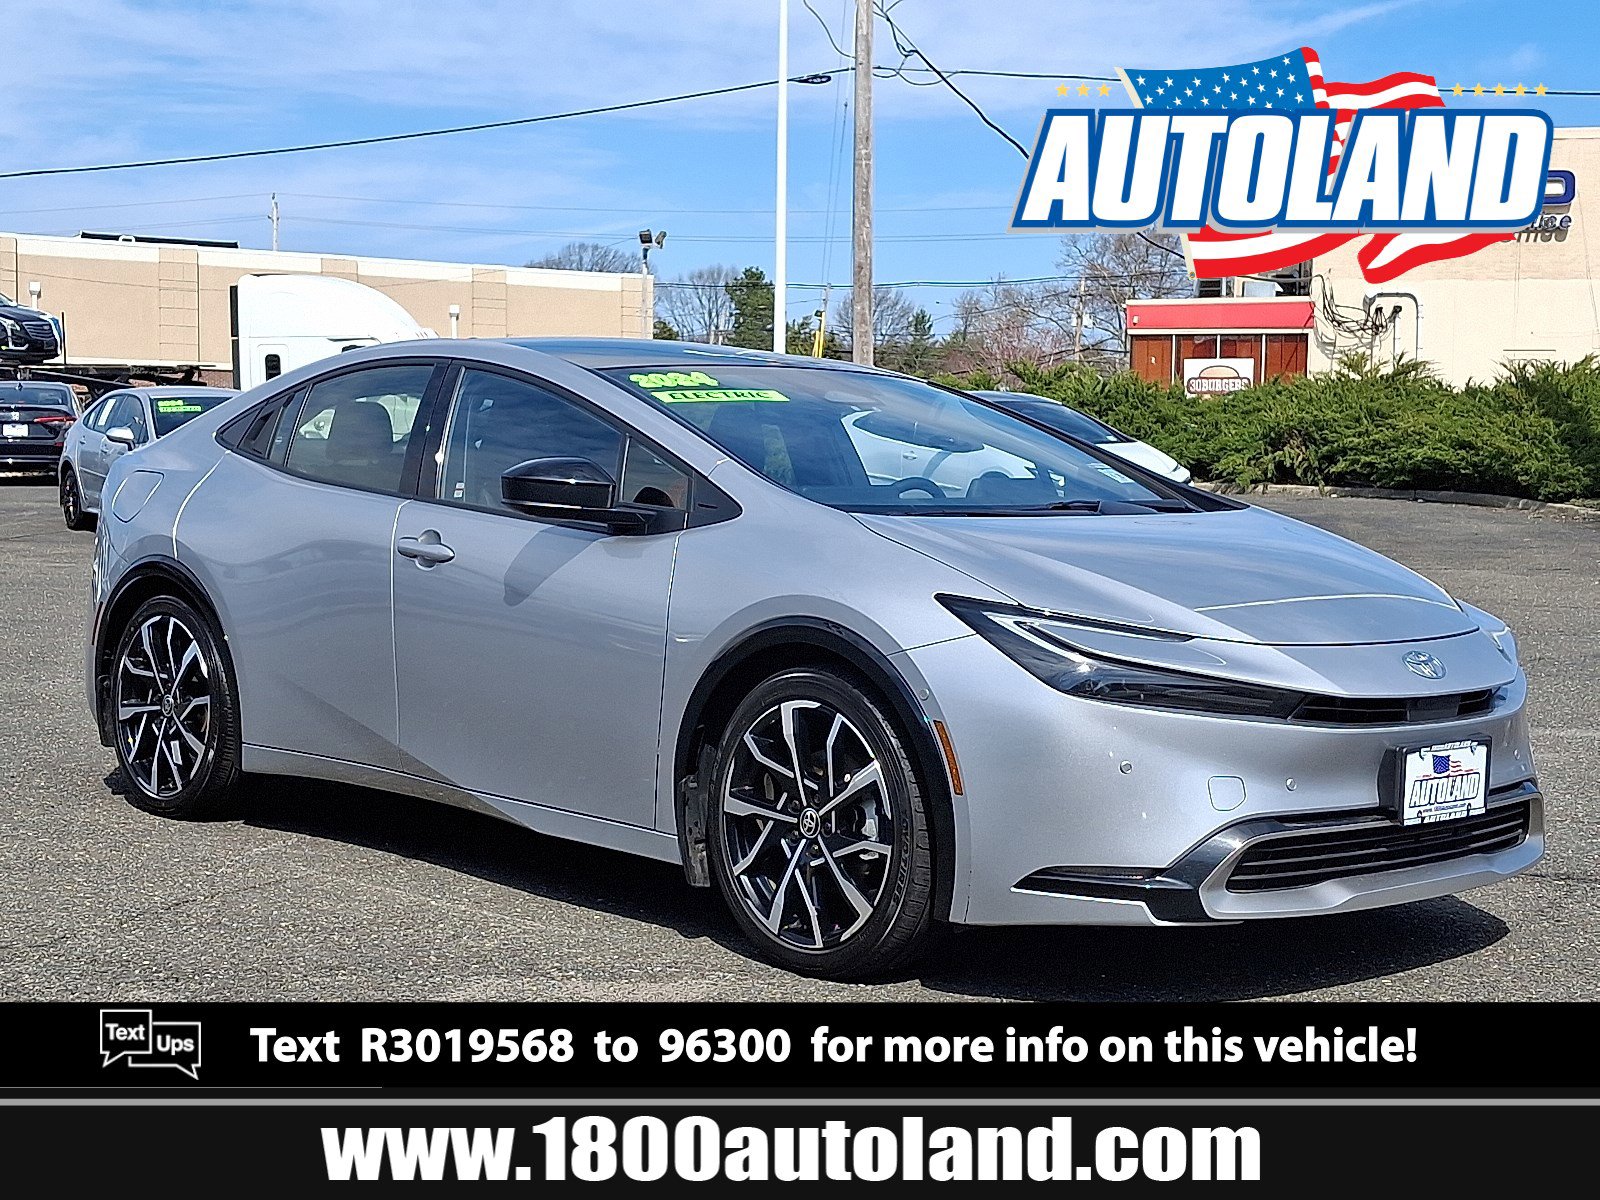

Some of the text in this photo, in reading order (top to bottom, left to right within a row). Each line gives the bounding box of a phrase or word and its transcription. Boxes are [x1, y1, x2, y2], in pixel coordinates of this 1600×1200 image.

[629, 371, 719, 388] 2024
[668, 391, 771, 400] ELECTRIC
[1409, 773, 1481, 808] AUTOLAND
